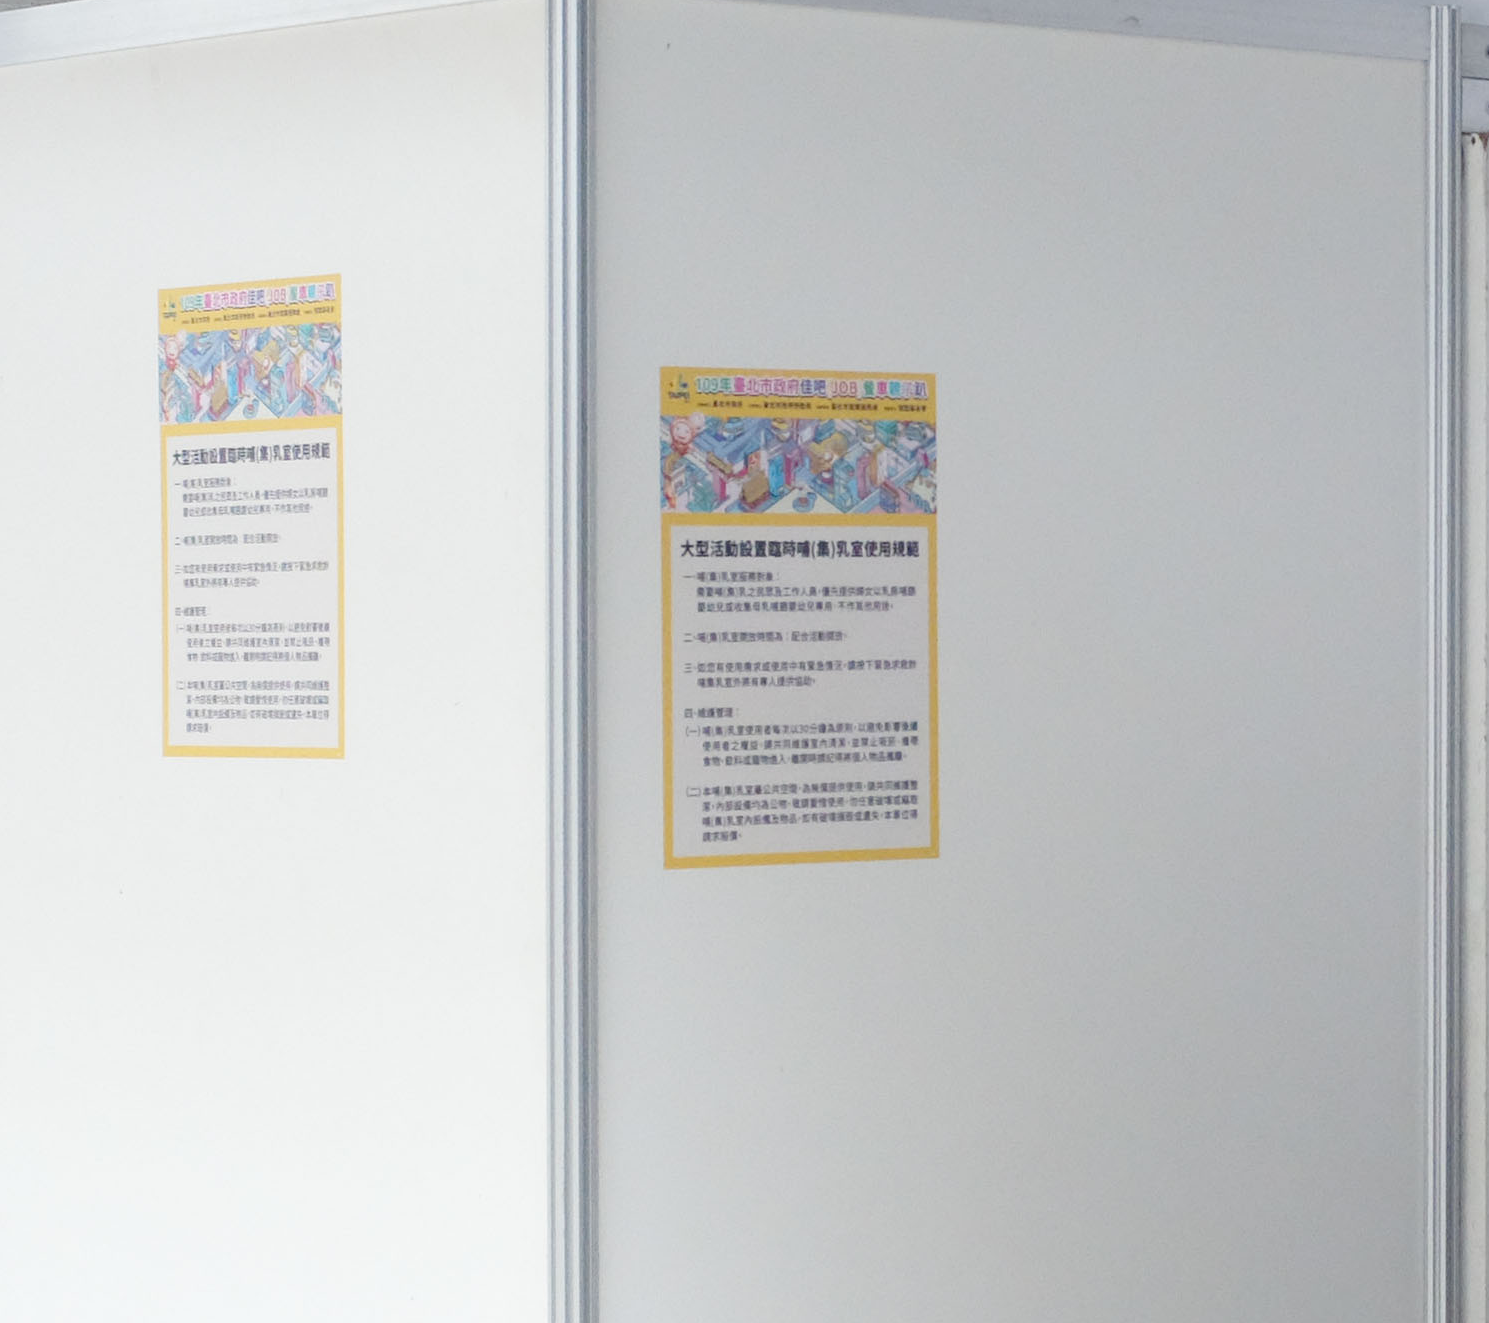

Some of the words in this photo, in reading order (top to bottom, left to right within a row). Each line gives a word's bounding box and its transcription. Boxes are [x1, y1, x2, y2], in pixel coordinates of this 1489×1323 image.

[680, 539, 920, 559] 大型活動設置臨時哺(集)乳室使用規範
